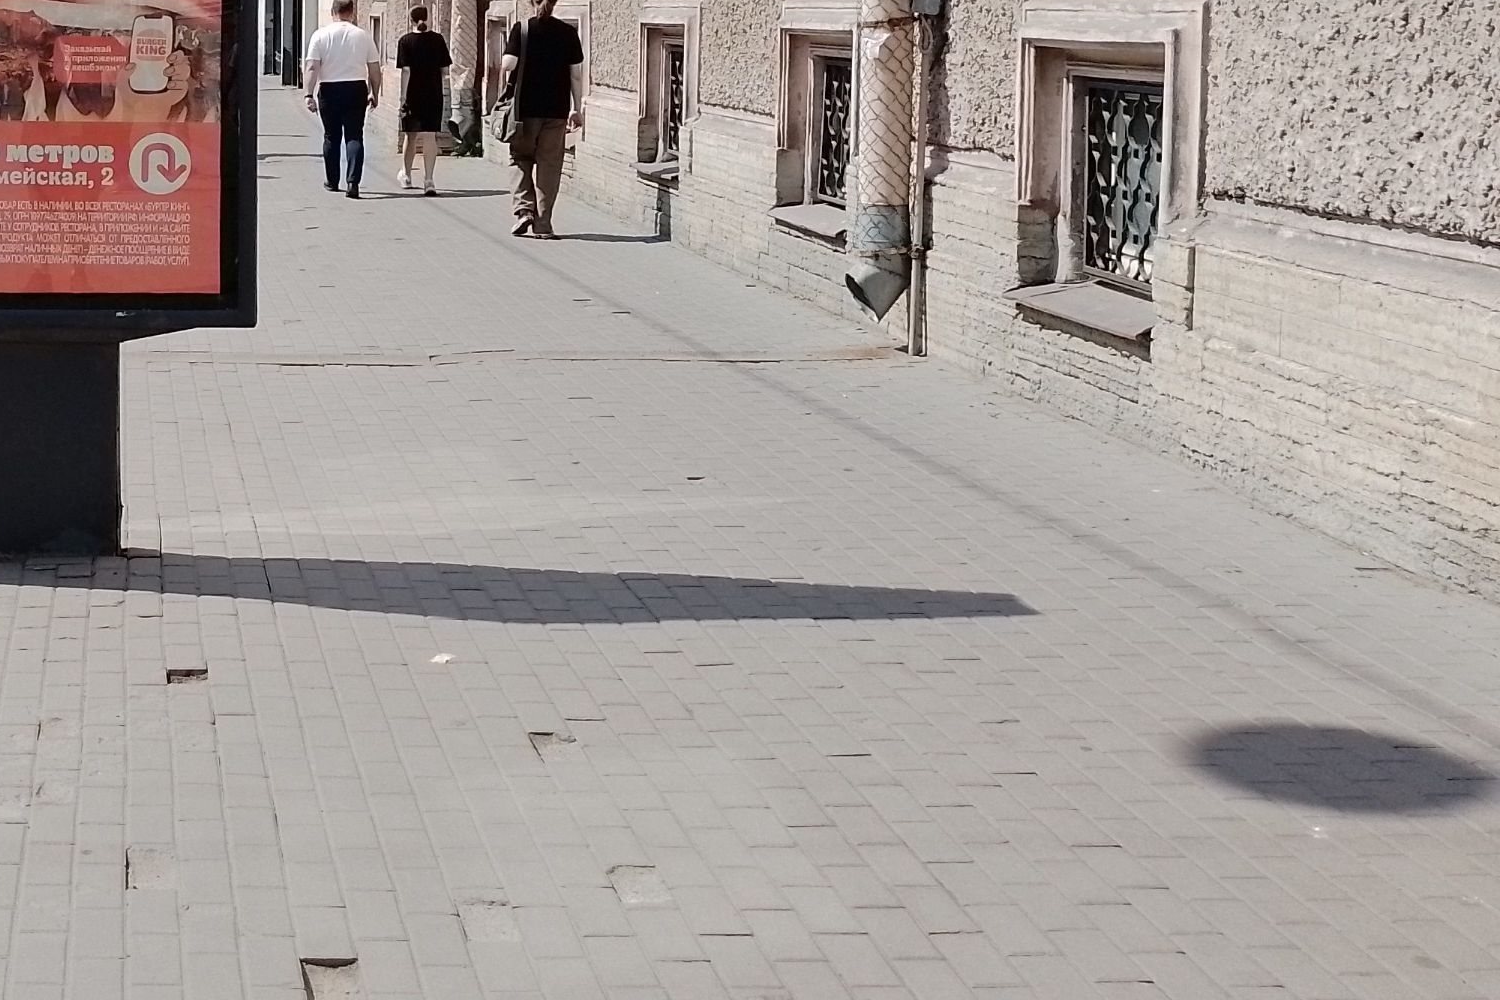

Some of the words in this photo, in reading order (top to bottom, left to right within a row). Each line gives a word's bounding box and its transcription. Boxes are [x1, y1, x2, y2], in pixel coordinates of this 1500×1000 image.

[136, 38, 167, 46] BURGER
[135, 45, 167, 56] KING
[6, 144, 115, 169] метров
[100, 167, 114, 186] 2
